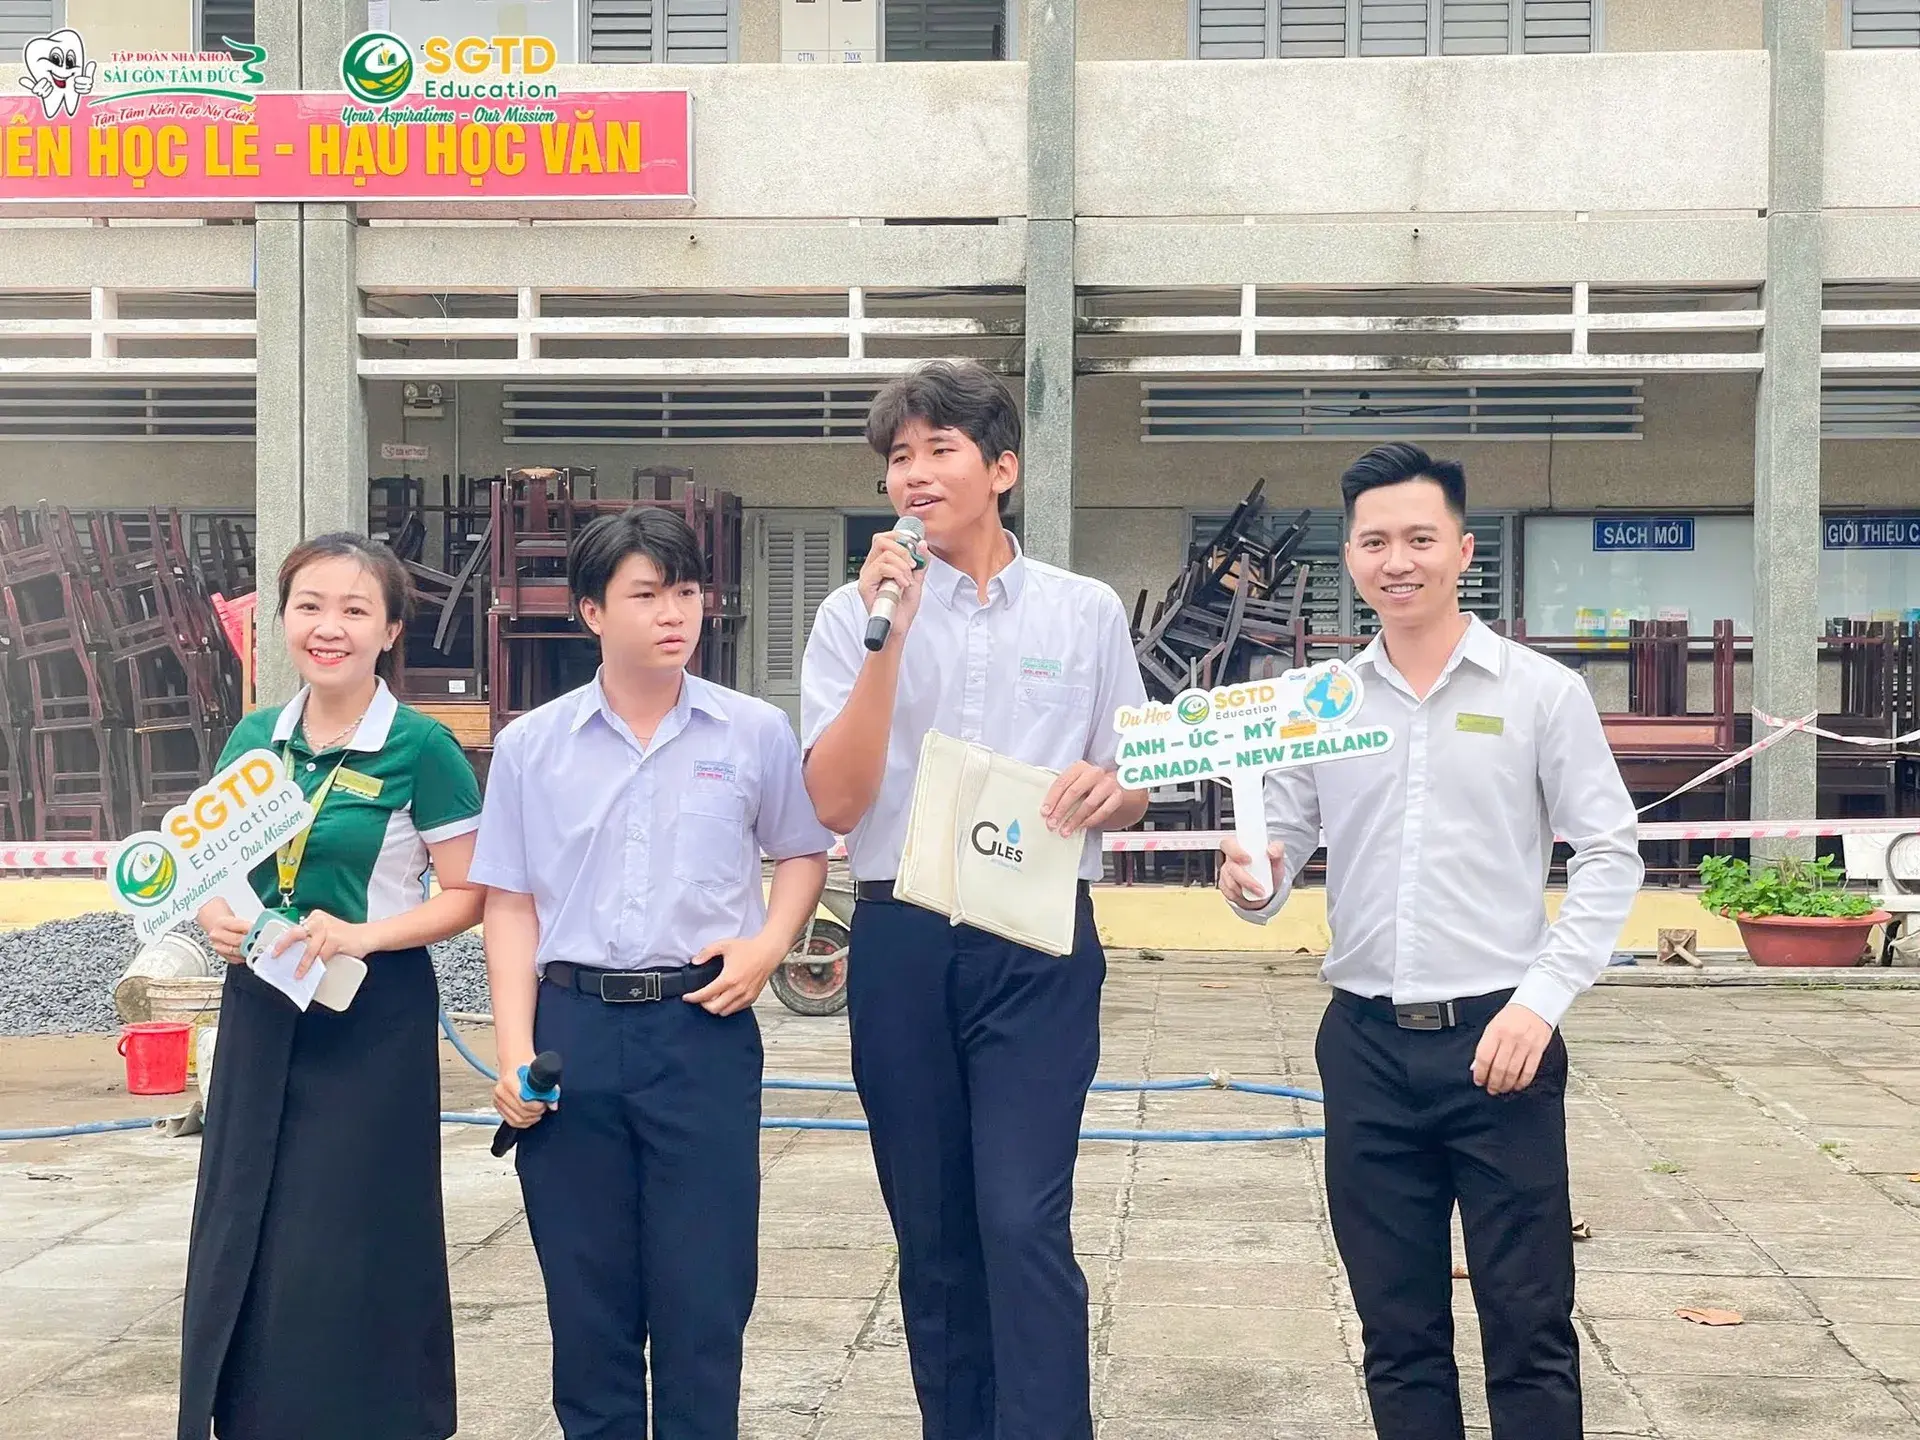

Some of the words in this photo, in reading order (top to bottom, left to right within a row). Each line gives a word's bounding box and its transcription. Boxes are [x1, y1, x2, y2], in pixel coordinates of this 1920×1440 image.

[0, 112, 72, 177] ÊN
[88, 124, 188, 188] HỌC
[425, 123, 527, 188] HỌC
[540, 109, 641, 175] VĂN
[1603, 522, 1648, 545] SÁCH
[1654, 522, 1684, 545] MỚI
[1827, 520, 1858, 543] GIỚI
[1862, 521, 1905, 546] THIỆU
[1119, 711, 1142, 728] Du
[1145, 707, 1172, 726] Học
[1214, 685, 1276, 710] SGTD
[1215, 703, 1278, 720] Education
[1122, 738, 1165, 760] ANH
[1189, 729, 1219, 749] ÚC
[1244, 717, 1276, 740] MỸ
[1123, 756, 1214, 784] CANADA
[1236, 745, 1286, 768] NEW
[1290, 730, 1389, 760] ZEALAND
[170, 758, 275, 850] SGTD
[189, 788, 293, 871] Education
[971, 820, 1024, 863] GLES
[142, 910, 171, 936] Your
[171, 866, 229, 917] Aspirations
[240, 842, 264, 862] Our
[263, 810, 304, 847] Mission
